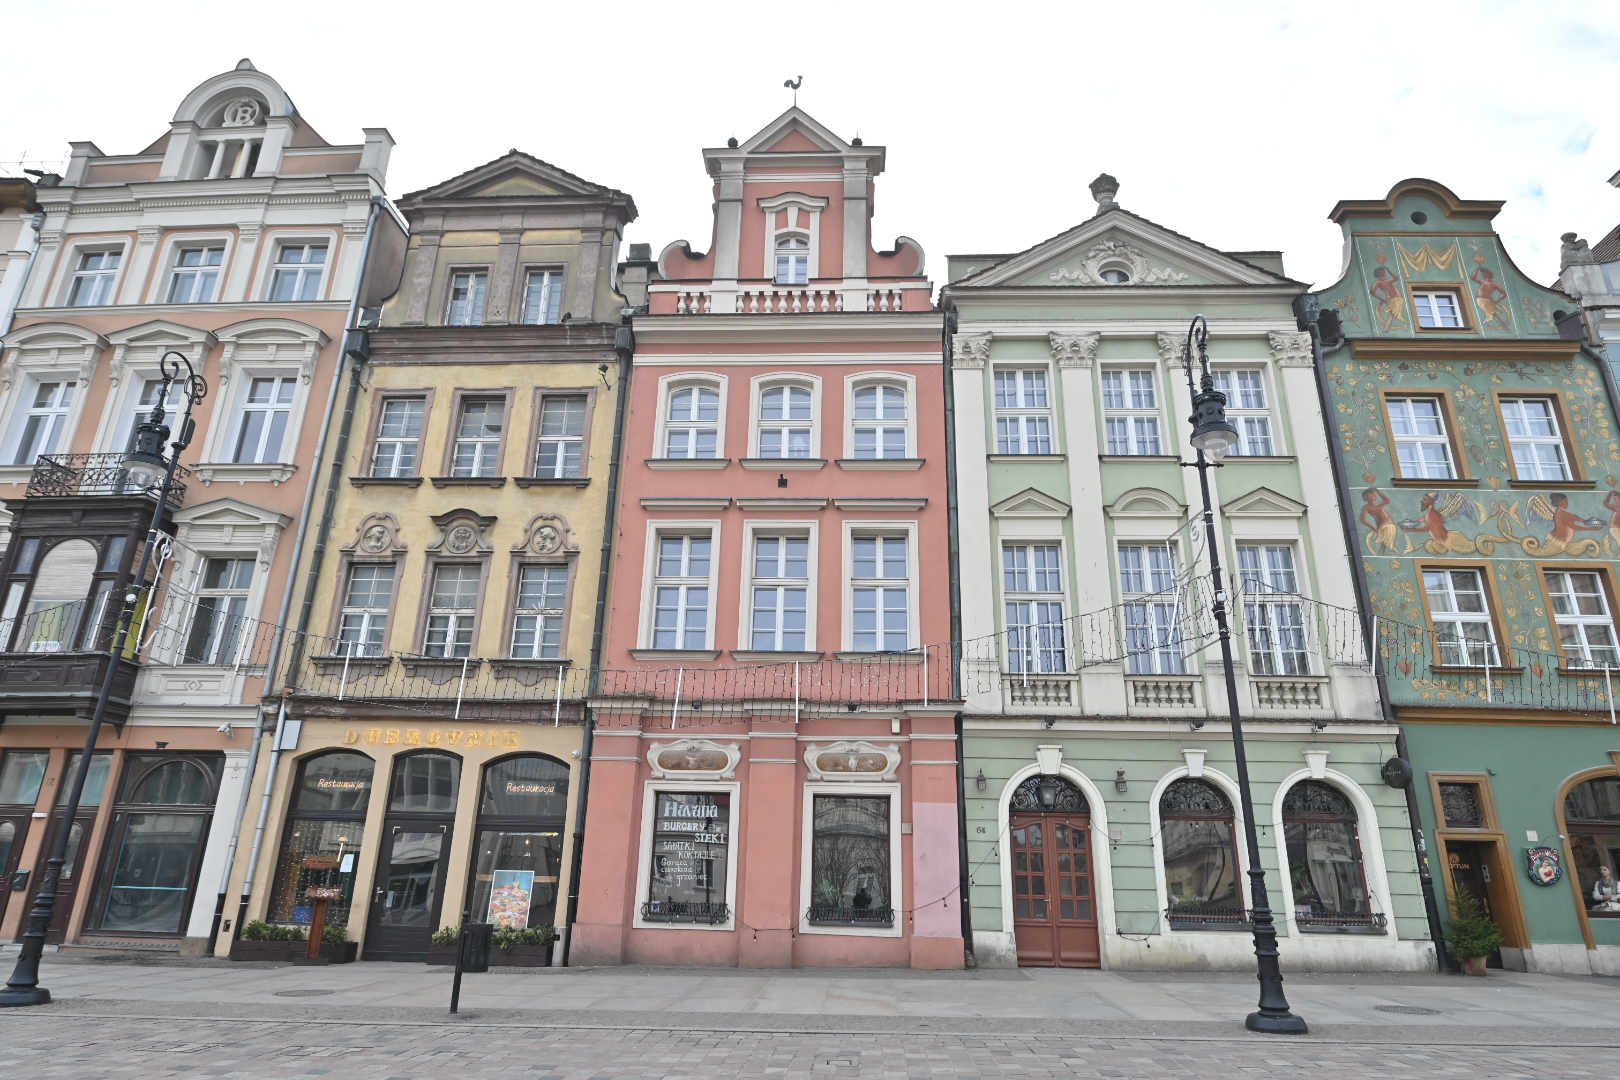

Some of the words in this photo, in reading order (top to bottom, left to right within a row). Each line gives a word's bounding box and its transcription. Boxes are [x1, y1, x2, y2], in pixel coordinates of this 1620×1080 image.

[342, 729, 519, 747] DUBROVNIK
[317, 778, 364, 791] Restauracja
[506, 782, 556, 795] Restauracja
[663, 801, 719, 818] Havana
[663, 821, 706, 831] BURGERY
[694, 832, 725, 844] STEKI
